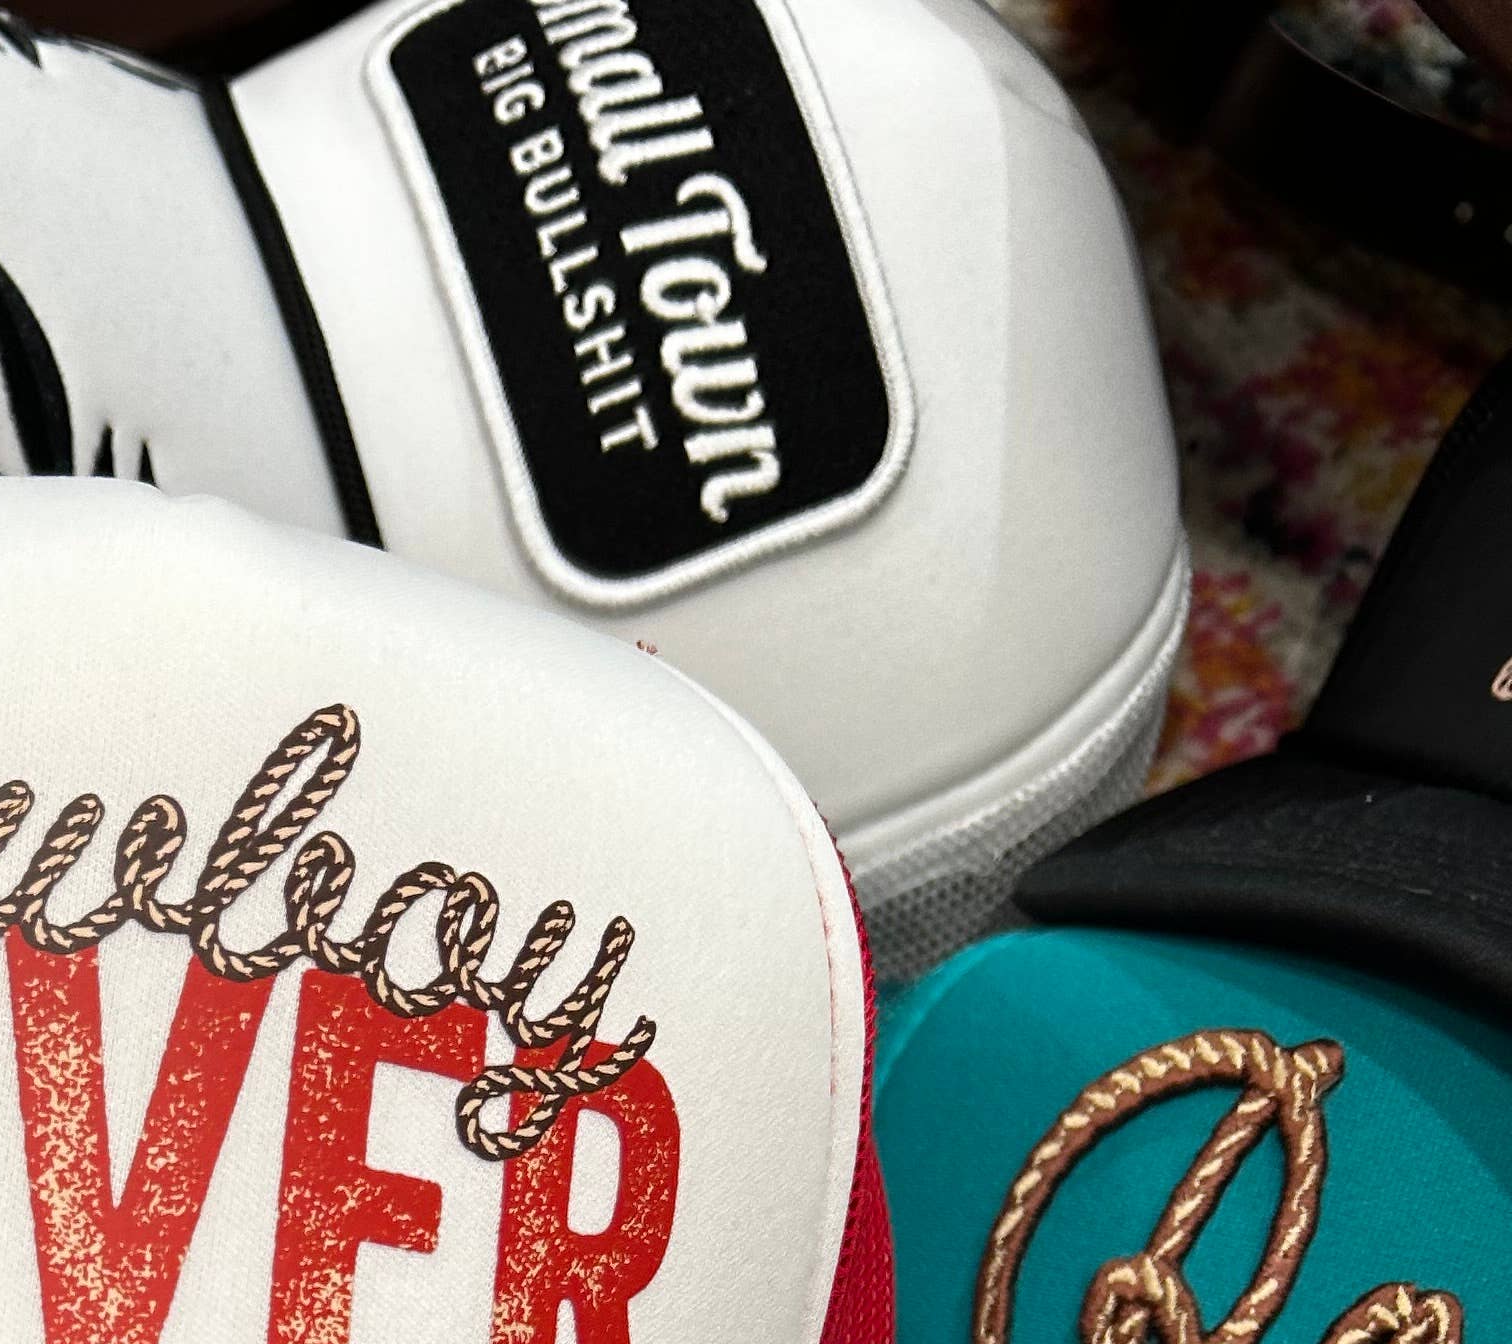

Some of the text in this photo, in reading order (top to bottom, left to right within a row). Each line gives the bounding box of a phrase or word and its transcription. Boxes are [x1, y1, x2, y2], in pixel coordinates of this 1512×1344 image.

[471, 34, 659, 452] BIG BULLSHIT
[528, 0, 782, 524] mall Town
